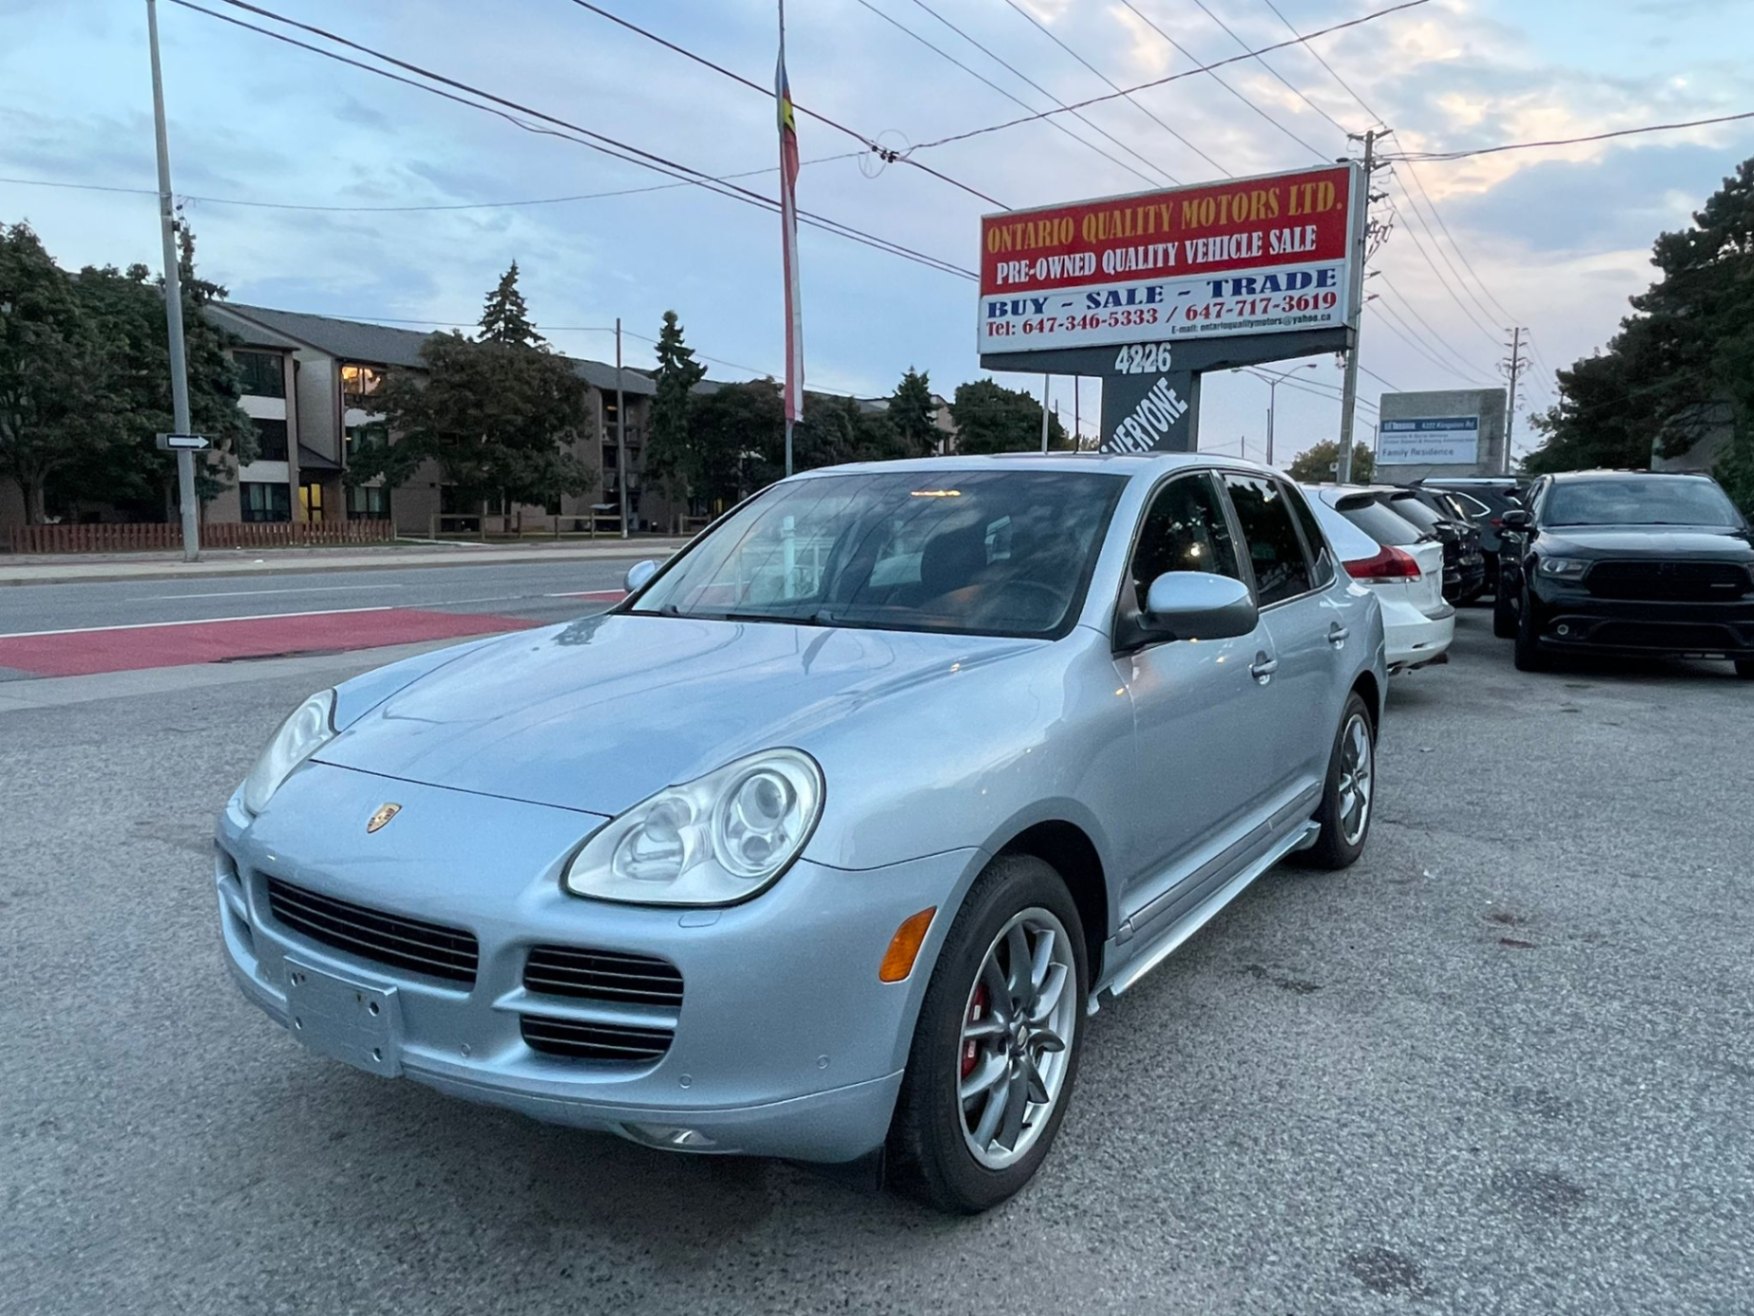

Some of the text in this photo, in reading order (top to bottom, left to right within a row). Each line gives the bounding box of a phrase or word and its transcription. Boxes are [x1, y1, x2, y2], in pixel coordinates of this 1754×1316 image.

[987, 180, 1343, 254] ONTARIO QUALITY MOTORS LTD.
[996, 225, 1317, 285] PRE-OWNED QUALITY VEHICLE SALE
[986, 291, 1337, 336] Tel: 647-346-5333 / 647-717-3619
[987, 296, 1049, 319] BUY
[1086, 285, 1164, 310] SALE
[1207, 268, 1337, 298] TRADE
[1115, 342, 1172, 375] 4226
[1101, 377, 1188, 453] VERYONE
[1382, 447, 1454, 457] Family Residence
